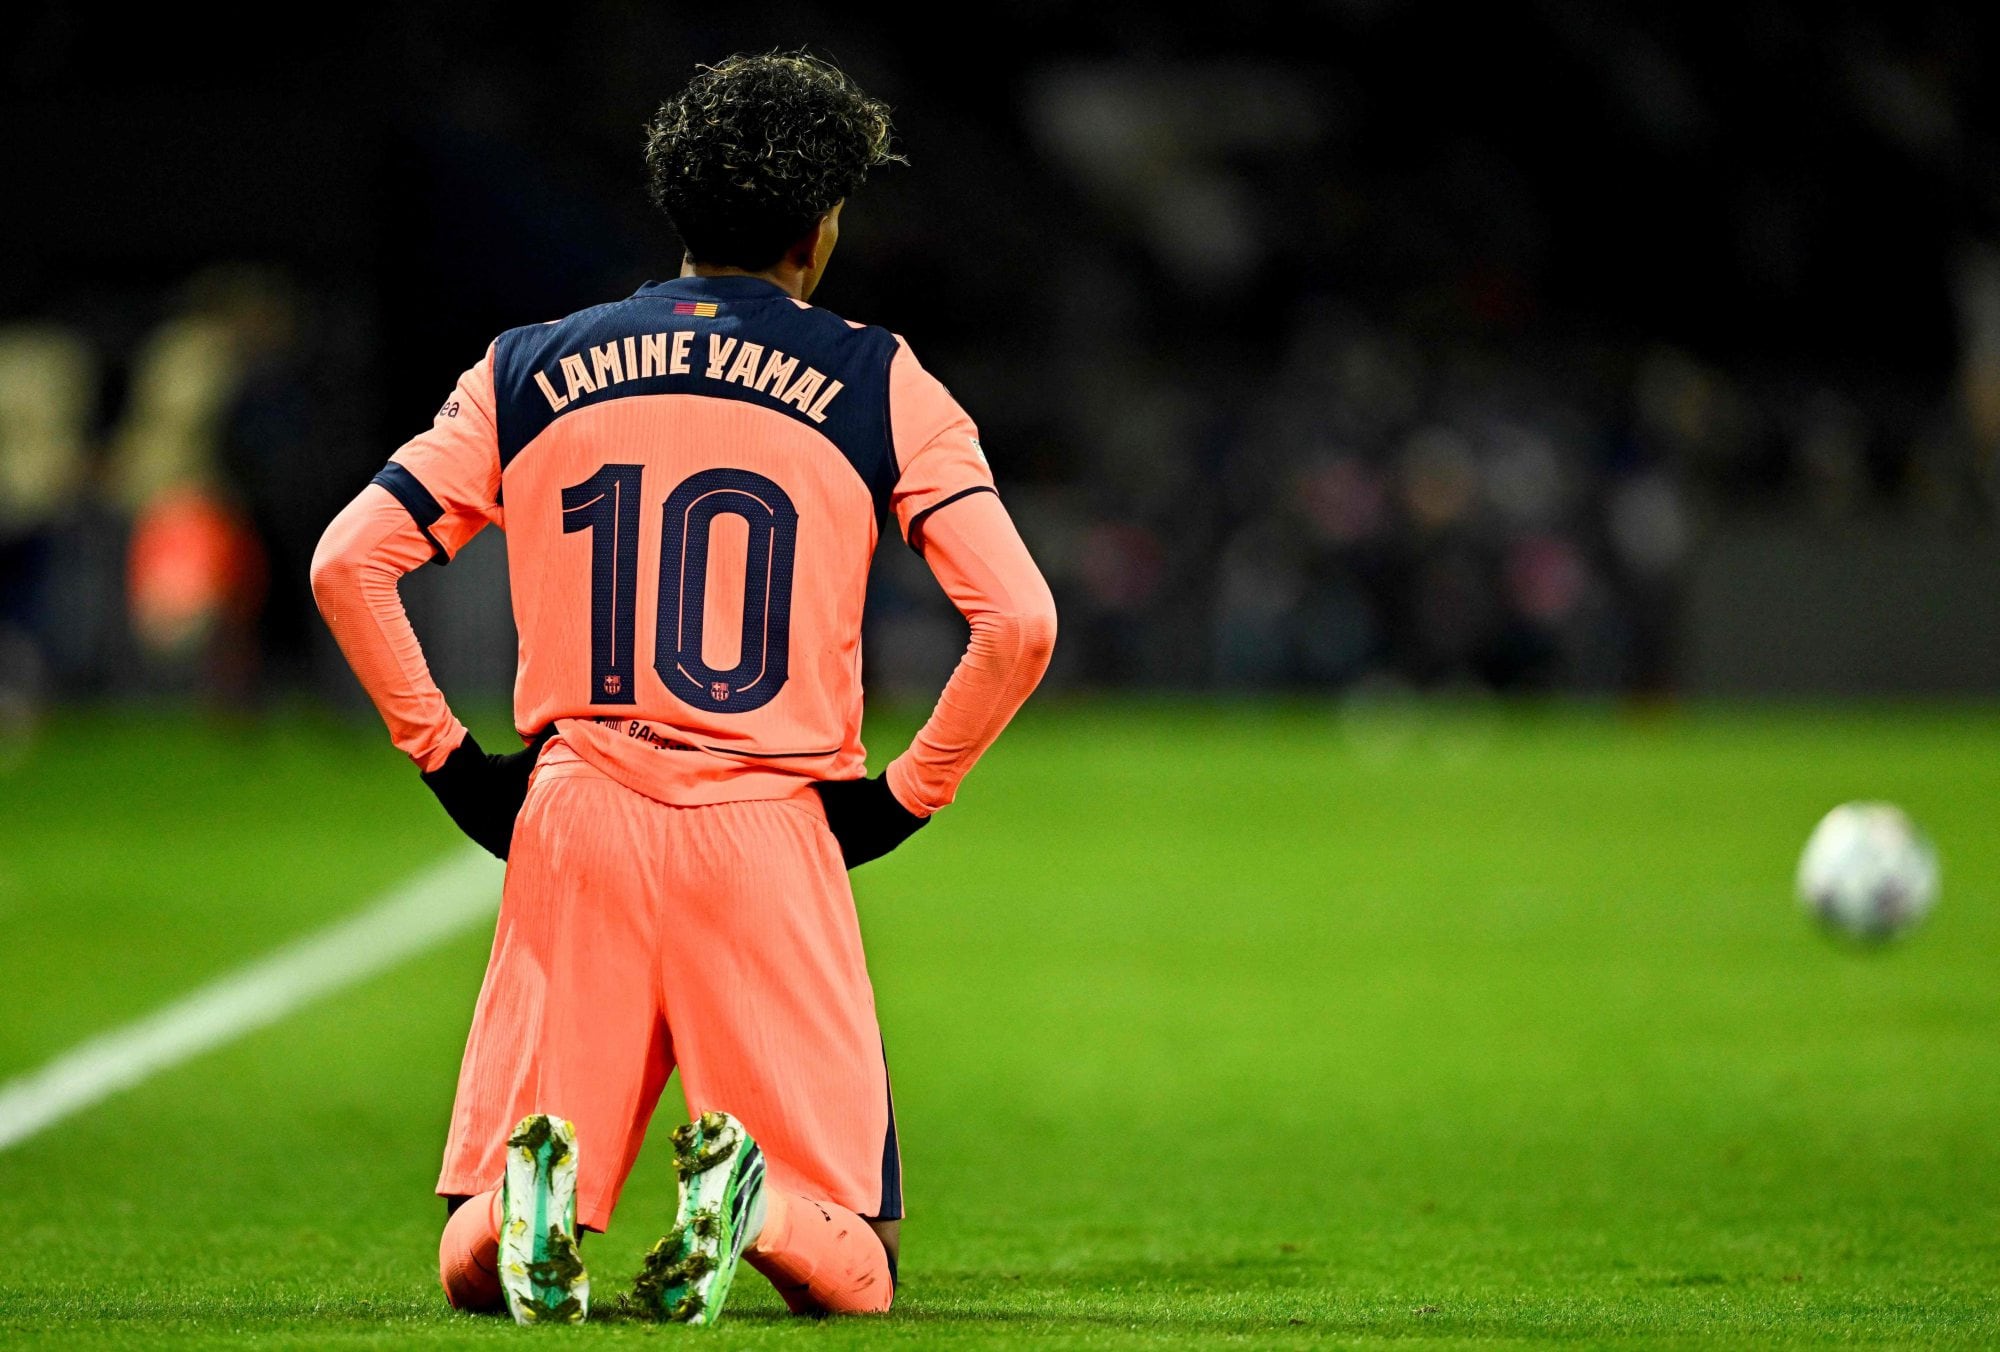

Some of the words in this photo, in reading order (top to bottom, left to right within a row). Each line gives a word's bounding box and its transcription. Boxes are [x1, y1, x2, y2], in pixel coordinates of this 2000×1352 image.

[533, 330, 696, 413] LAMINE
[705, 333, 845, 425] YAMAL
[561, 464, 799, 714] 10
